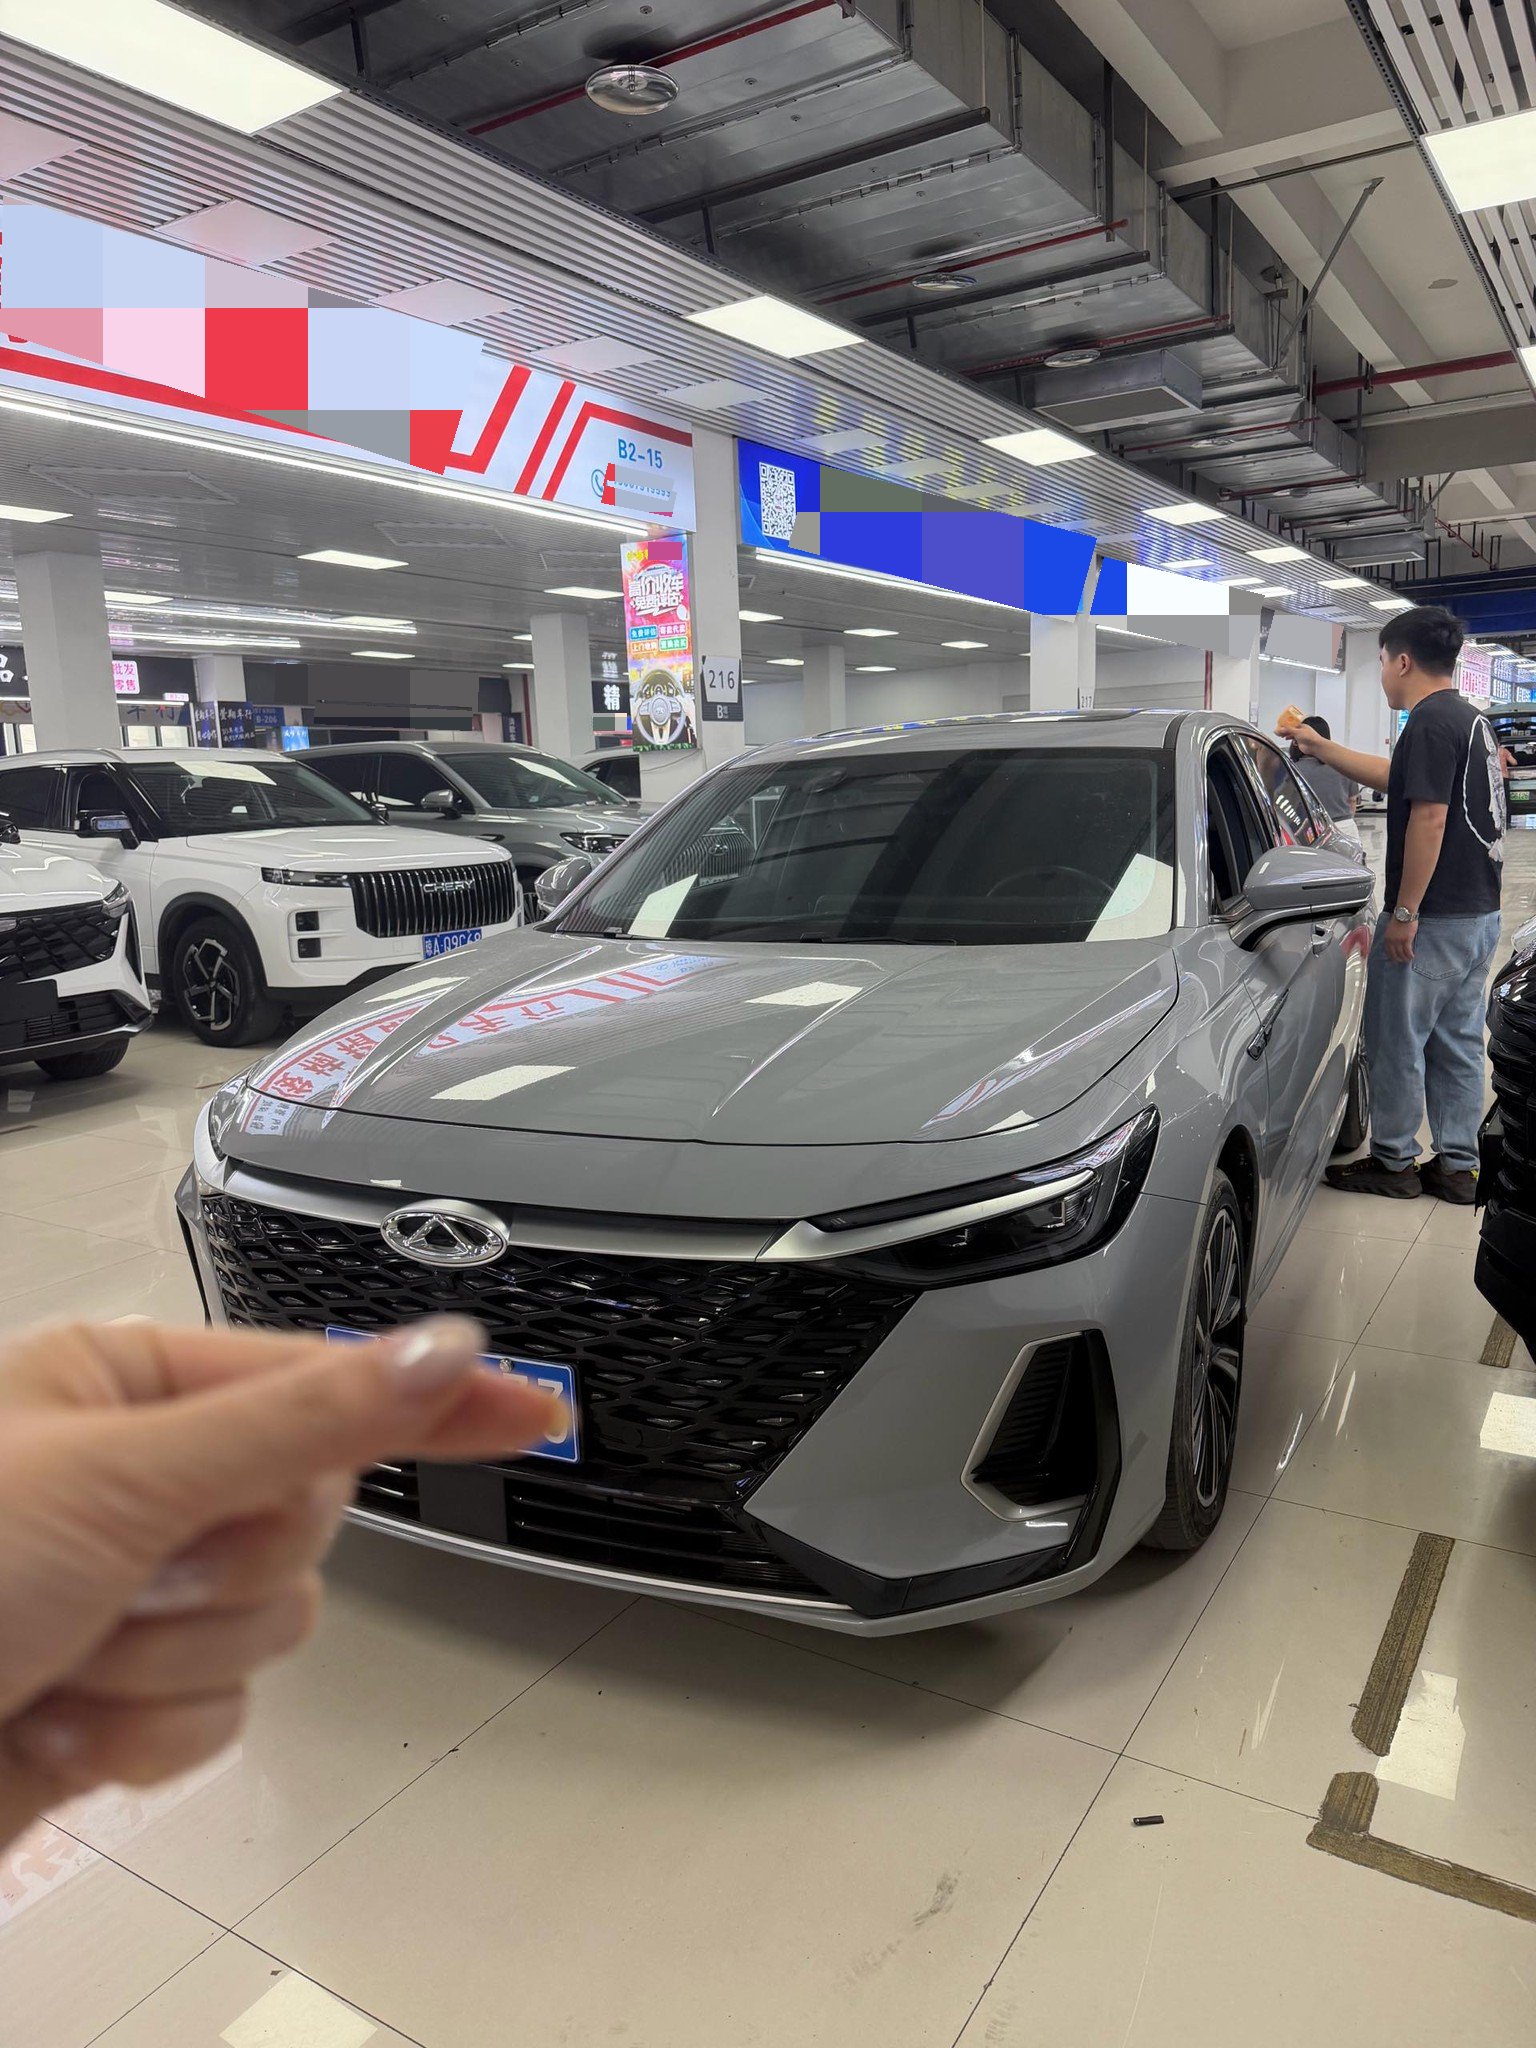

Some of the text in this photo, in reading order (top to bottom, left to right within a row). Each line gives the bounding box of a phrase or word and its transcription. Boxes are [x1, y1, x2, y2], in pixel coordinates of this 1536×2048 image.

[617, 438, 663, 469] B2-15
[628, 571, 685, 597] 高价收车
[112, 663, 135, 675] 批发
[708, 669, 735, 690] 216
[115, 679, 136, 691] 零售
[603, 684, 620, 711] 精
[422, 879, 475, 894] CHERY
